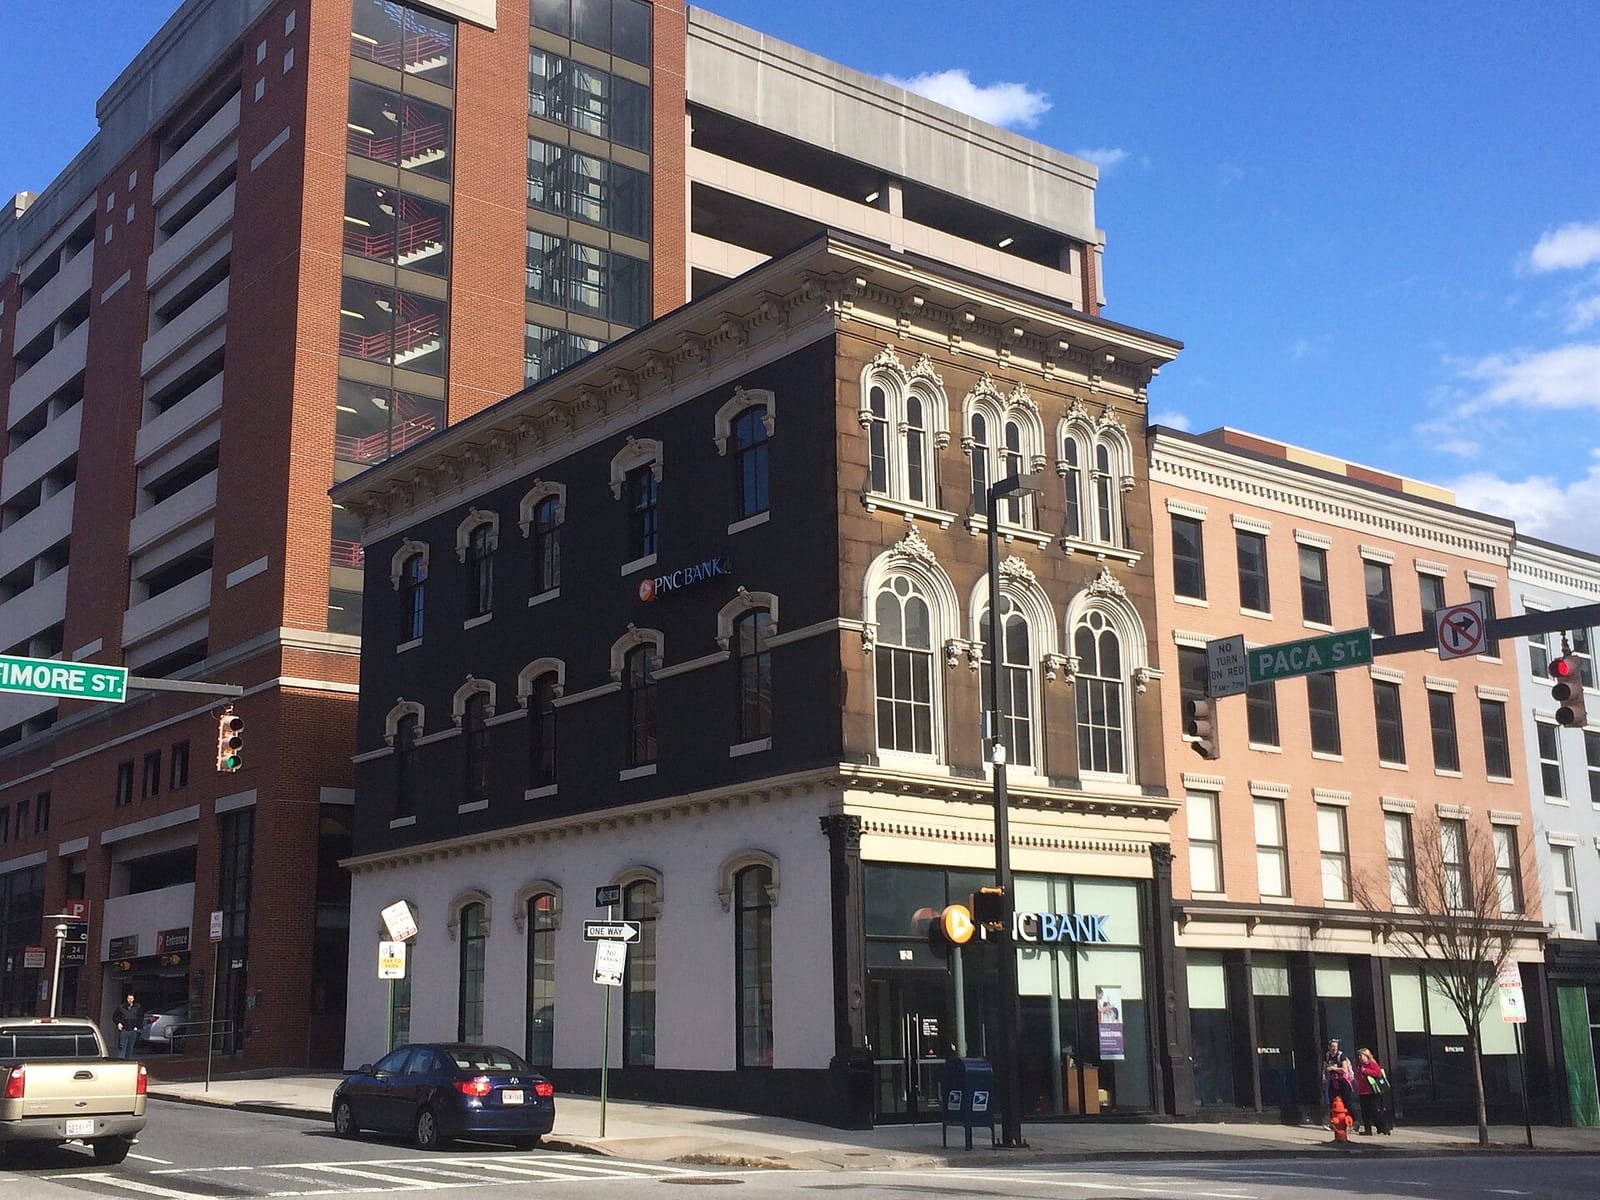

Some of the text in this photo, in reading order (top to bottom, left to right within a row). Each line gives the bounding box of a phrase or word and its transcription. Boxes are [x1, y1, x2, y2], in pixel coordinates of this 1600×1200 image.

[654, 558, 723, 595] PNC BANK
[1219, 643, 1231, 653] NO
[1216, 655, 1237, 667] TURN
[1259, 640, 1361, 676] PACA ST.
[0, 662, 122, 693] IMORE ST.
[1211, 666, 1244, 680] ON RED
[73, 903, 85, 916] P
[589, 927, 623, 936] ONE WAY
[1040, 912, 1111, 943] BANK
[71, 946, 81, 954] 24
[606, 949, 617, 957] NO
